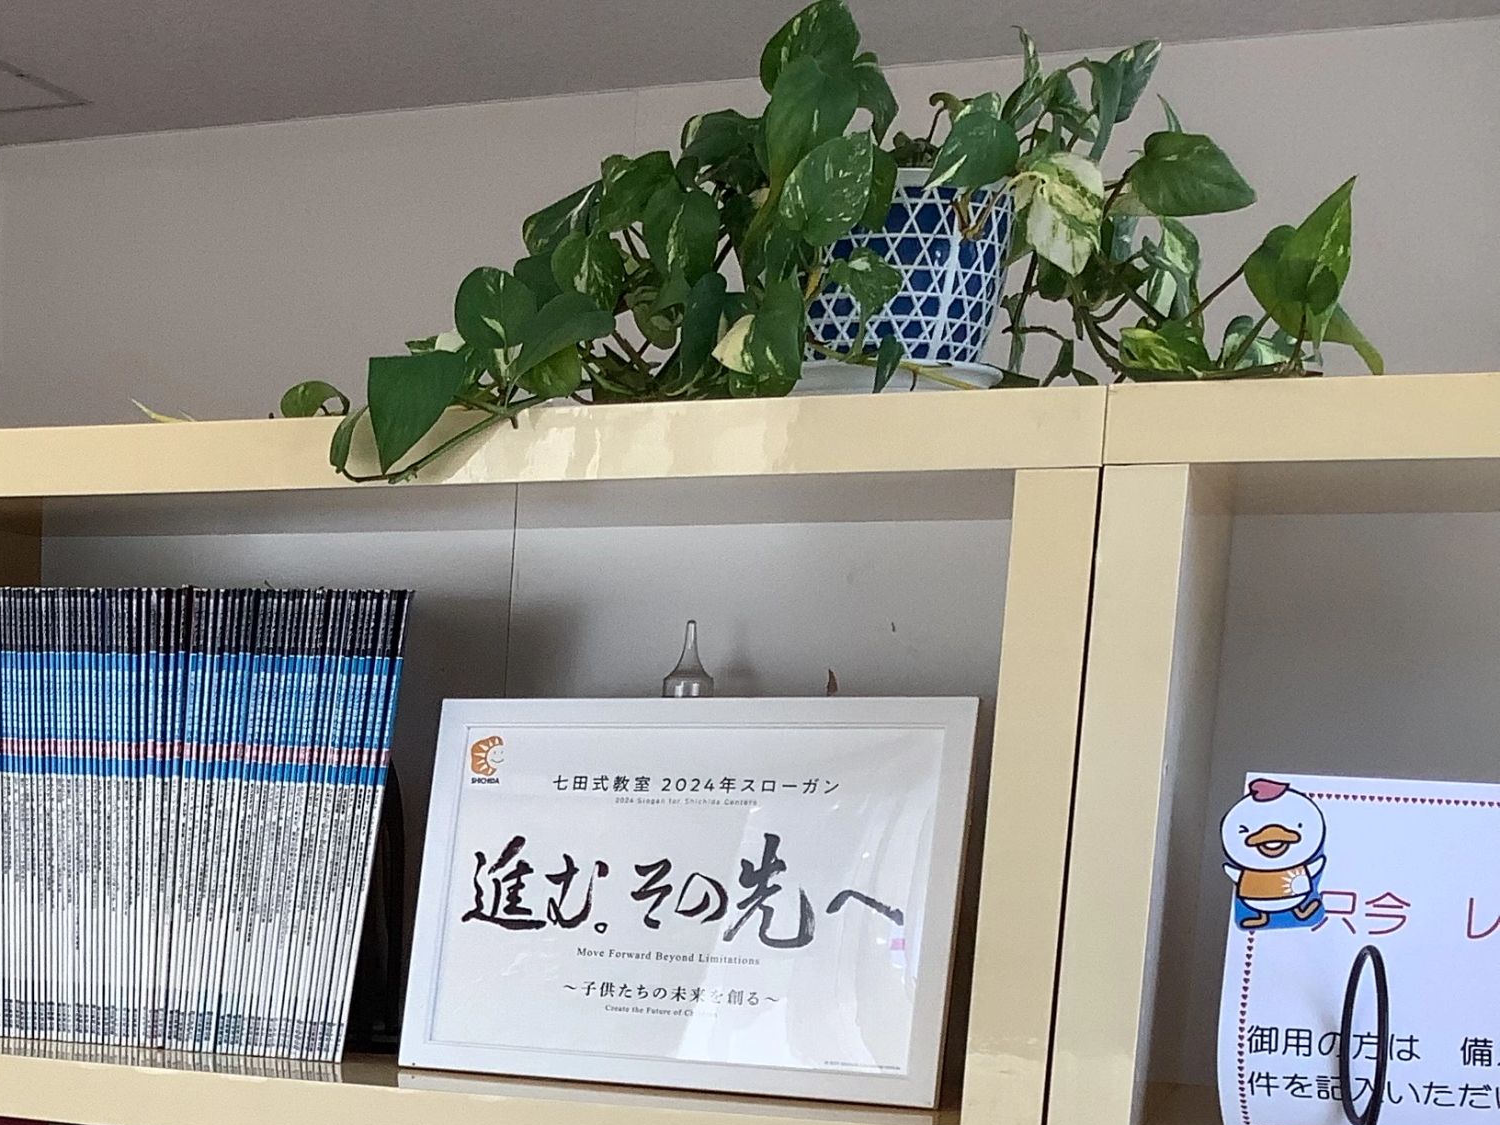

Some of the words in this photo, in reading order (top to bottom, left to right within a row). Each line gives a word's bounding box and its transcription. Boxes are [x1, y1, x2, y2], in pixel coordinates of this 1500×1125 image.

[471, 777, 500, 785] SHICHIDA
[552, 774, 651, 793] 七田式教室
[661, 776, 840, 797] 2024年スローガン
[637, 797, 666, 807] Slogan
[668, 797, 682, 805] for
[685, 797, 721, 806] Shichida
[723, 798, 758, 807] Centers
[461, 832, 906, 949] 進む。その先へ
[1311, 890, 1411, 937] 只今
[577, 947, 604, 958] Move
[609, 949, 651, 961] Forward
[656, 951, 694, 963] Beyond
[699, 953, 760, 966] Limitations
[605, 1004, 630, 1014] Create
[632, 1004, 644, 1013] the
[646, 1006, 672, 1016] Future
[1246, 1024, 1421, 1063] 御用の方は
[1460, 1035, 1500, 1068] 備
[1247, 1071, 1500, 1110] 件を記入いただ
